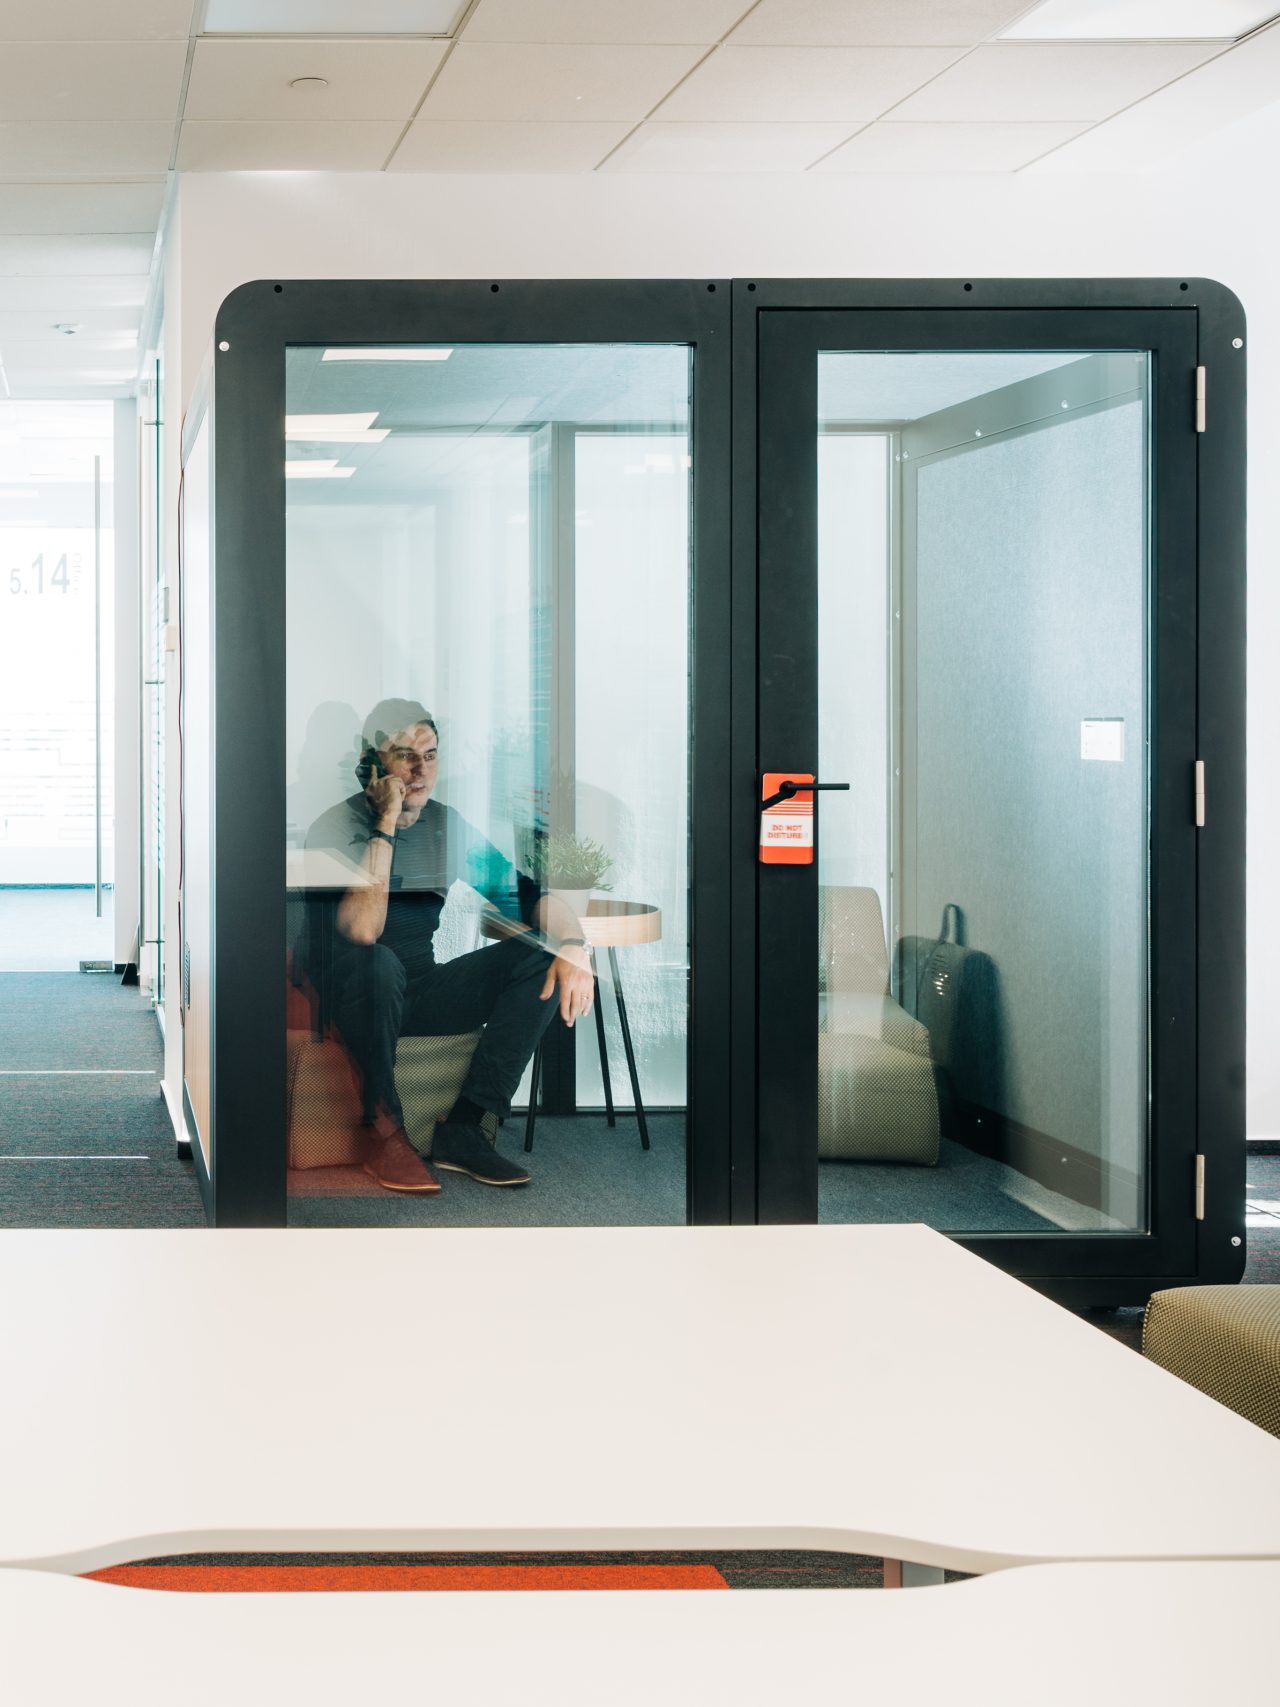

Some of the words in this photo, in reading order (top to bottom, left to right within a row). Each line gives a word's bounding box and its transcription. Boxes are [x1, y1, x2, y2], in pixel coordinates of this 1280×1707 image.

[9, 552, 71, 595] 5.14
[772, 824, 783, 832] DO
[786, 824, 803, 832] NOT
